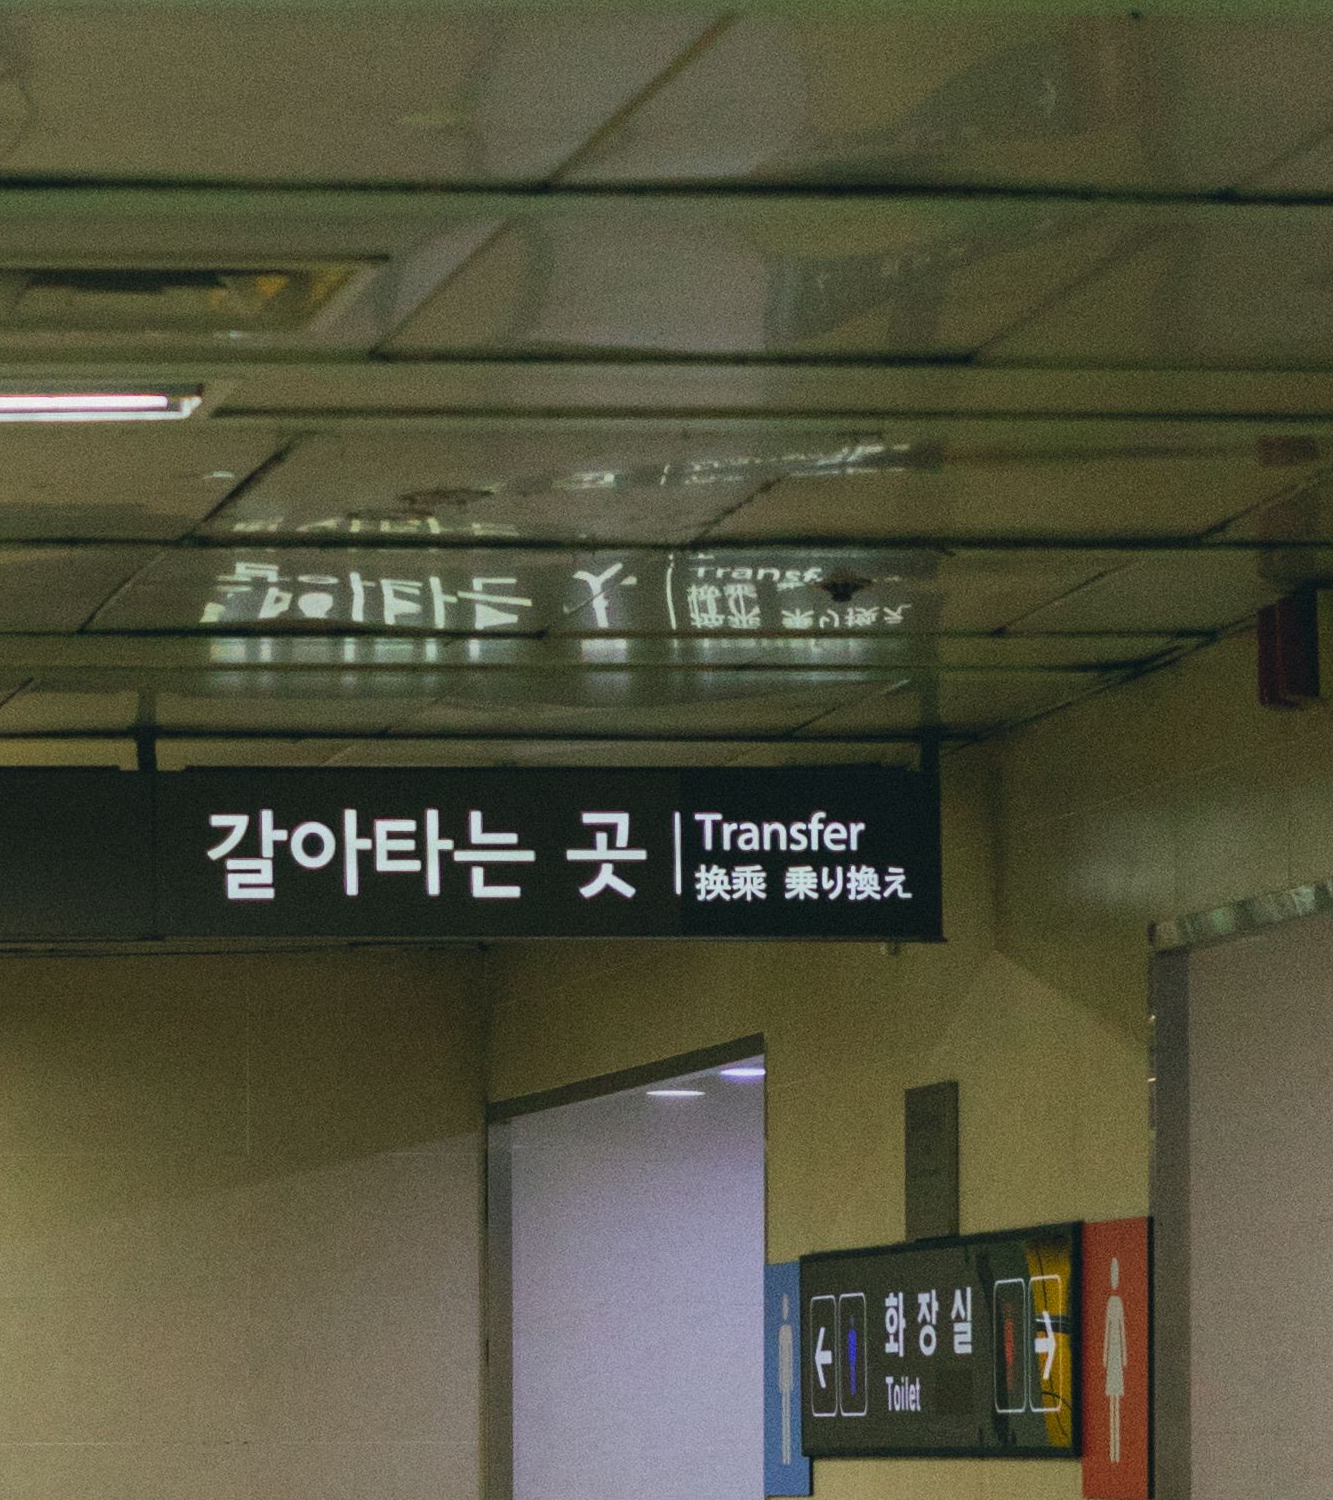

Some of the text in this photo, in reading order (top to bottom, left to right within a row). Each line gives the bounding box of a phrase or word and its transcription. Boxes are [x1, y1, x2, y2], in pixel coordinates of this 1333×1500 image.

[206, 808, 648, 900] 갈아타는 곳
[694, 811, 866, 852] Transfer
[884, 1286, 973, 1358] 화장실
[885, 1376, 921, 1412] Toilet
